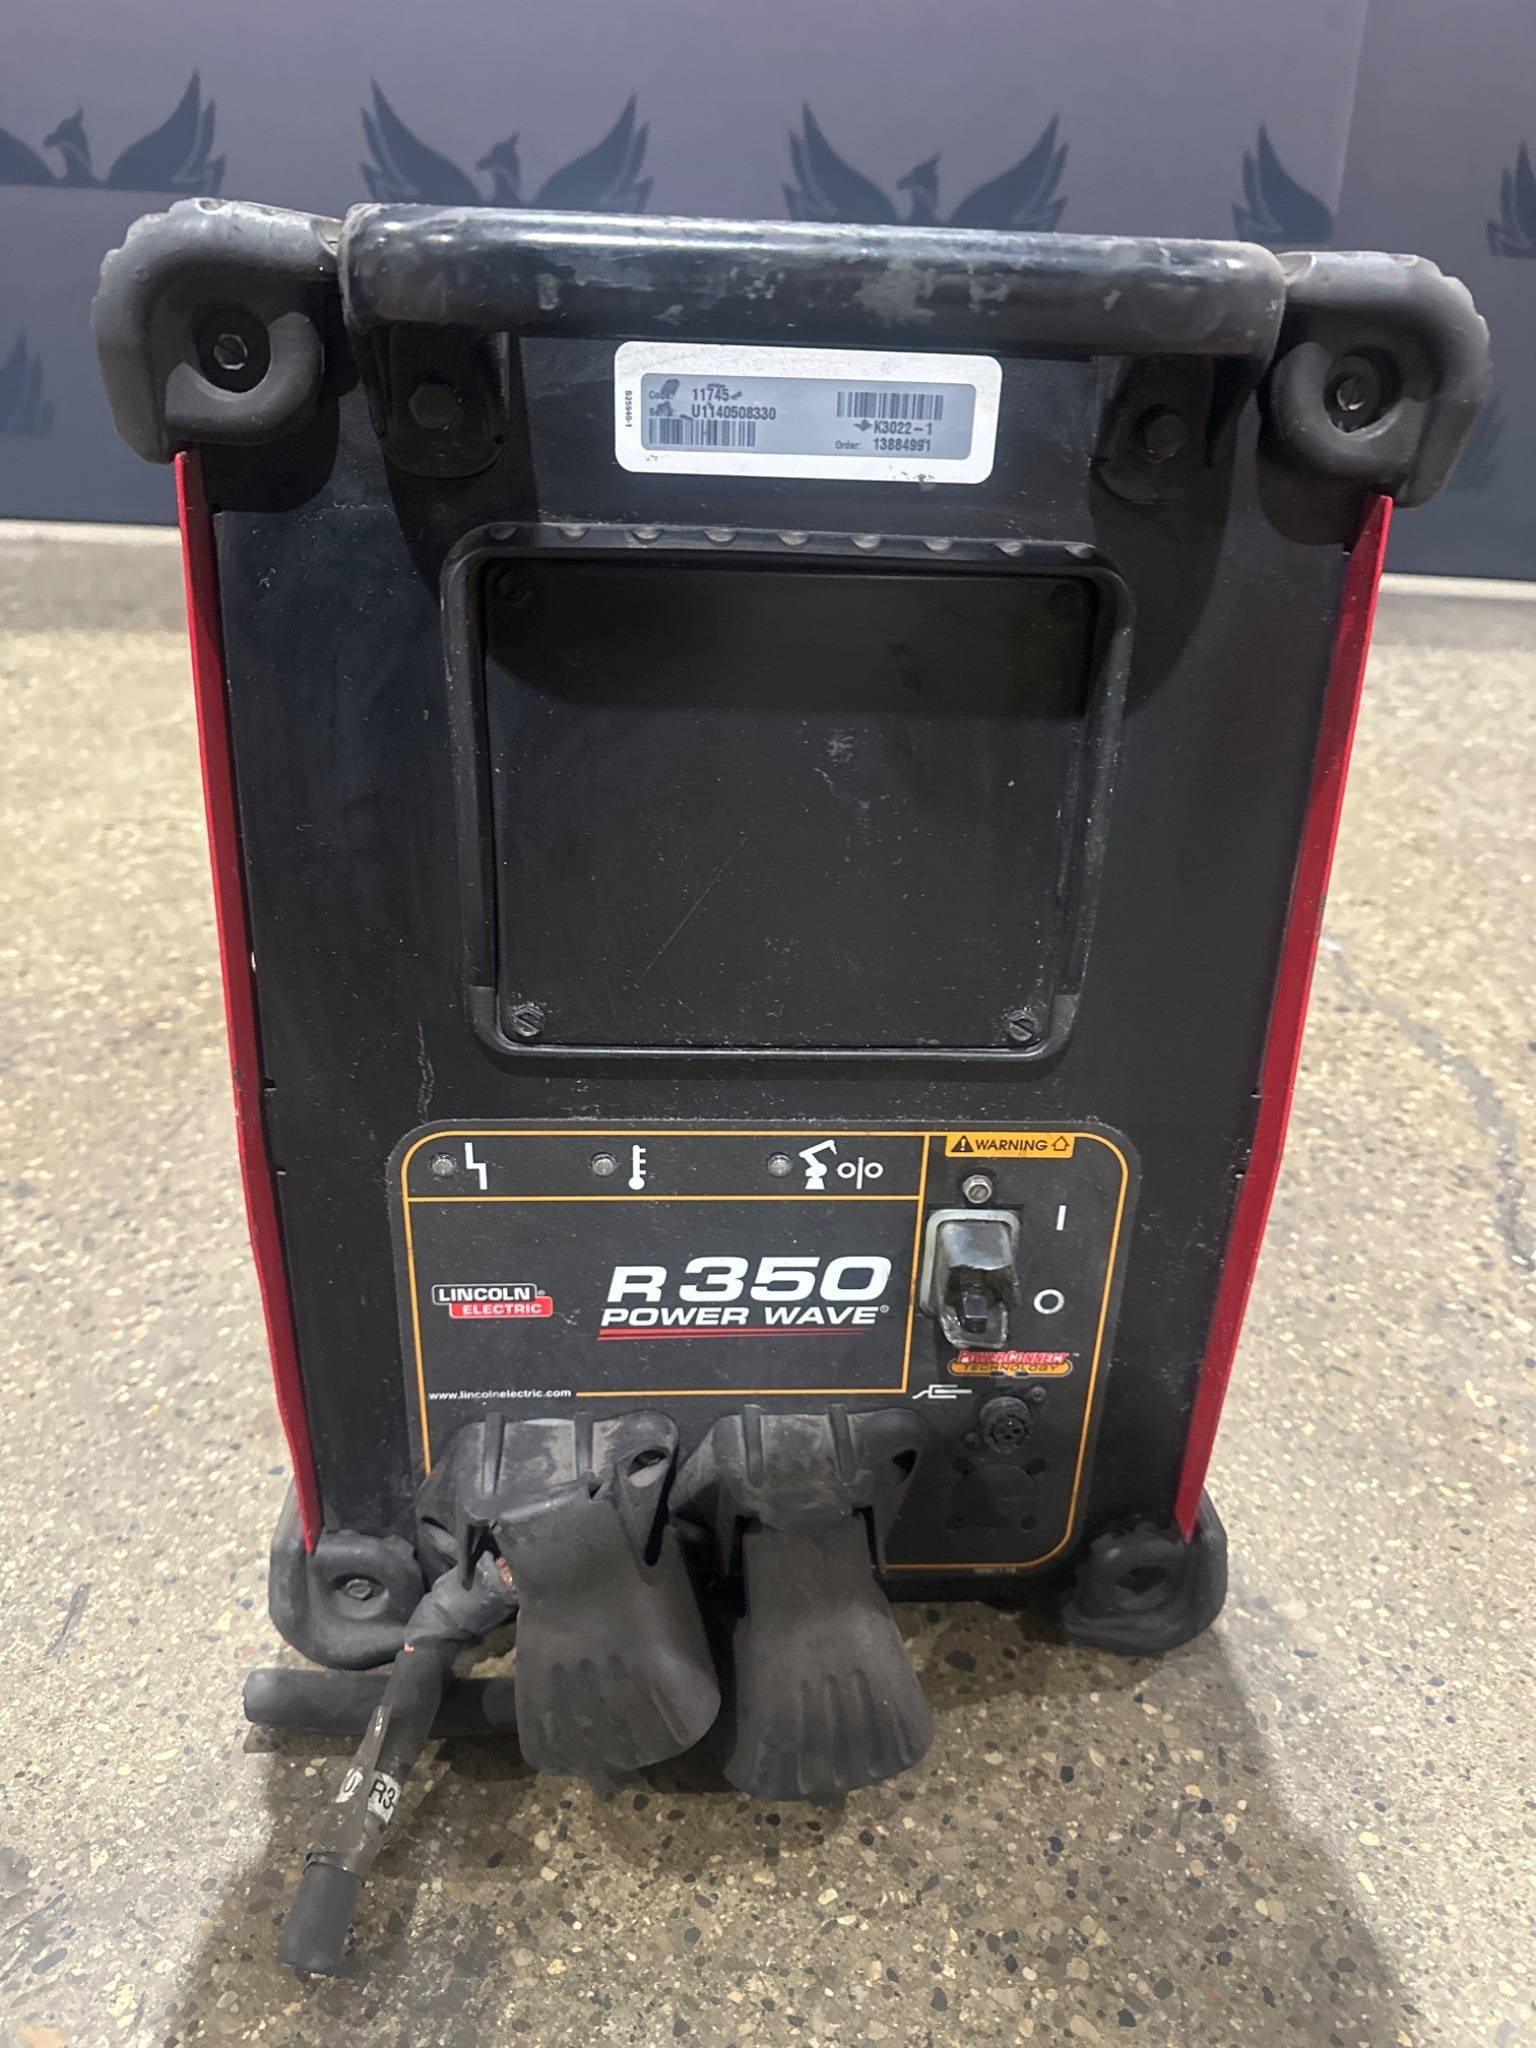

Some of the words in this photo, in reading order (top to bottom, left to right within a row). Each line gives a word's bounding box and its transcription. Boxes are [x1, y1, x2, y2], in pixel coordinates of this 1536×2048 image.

[692, 388, 730, 402] 11745
[691, 404, 777, 421] U1140508330
[834, 440, 862, 450] Order:
[873, 437, 931, 452] 13884991
[974, 1139, 1049, 1152] WARNING
[462, 1302, 543, 1316] ELECTRIC
[600, 1307, 748, 1327] POWER
[963, 1363, 1059, 1373] TECHNOLOGY
[428, 1389, 572, 1401] www.lincolnelectric.com
[368, 1778, 396, 1810] R3
